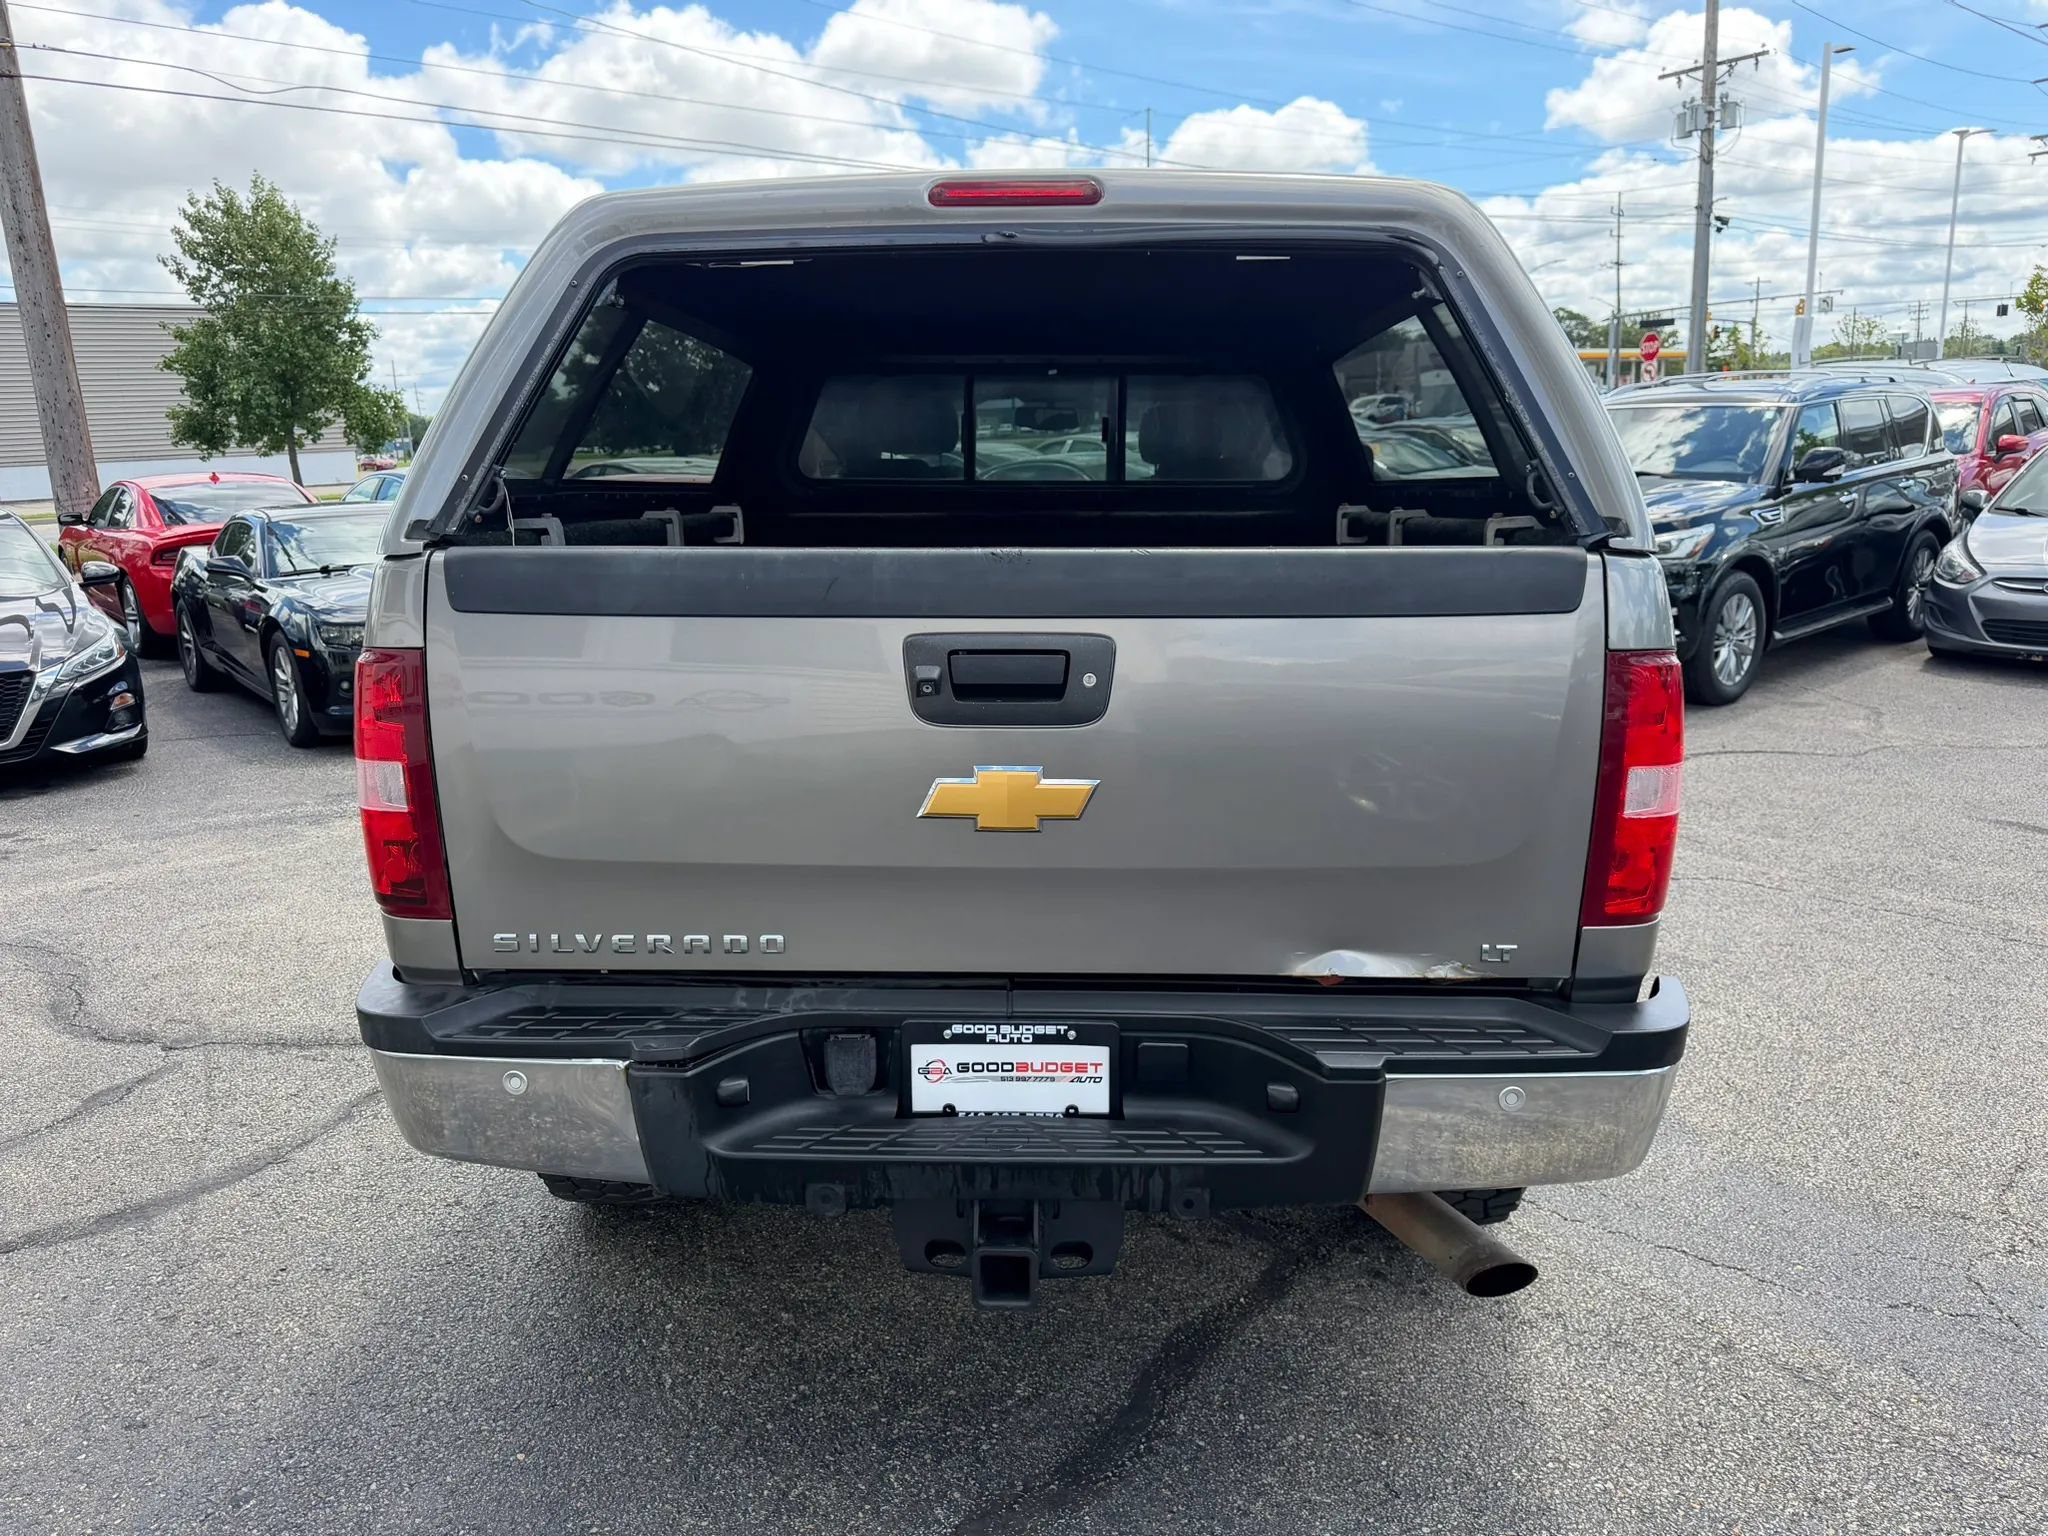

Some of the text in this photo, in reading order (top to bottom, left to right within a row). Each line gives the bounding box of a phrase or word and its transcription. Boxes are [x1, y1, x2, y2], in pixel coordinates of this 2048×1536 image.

[493, 933, 786, 954] SILVERADO
[1481, 944, 1518, 962] LT
[951, 1024, 1068, 1036] GOOD BUDGET
[986, 1034, 1033, 1043] AUTO
[1069, 1076, 1103, 1084] AUTO
